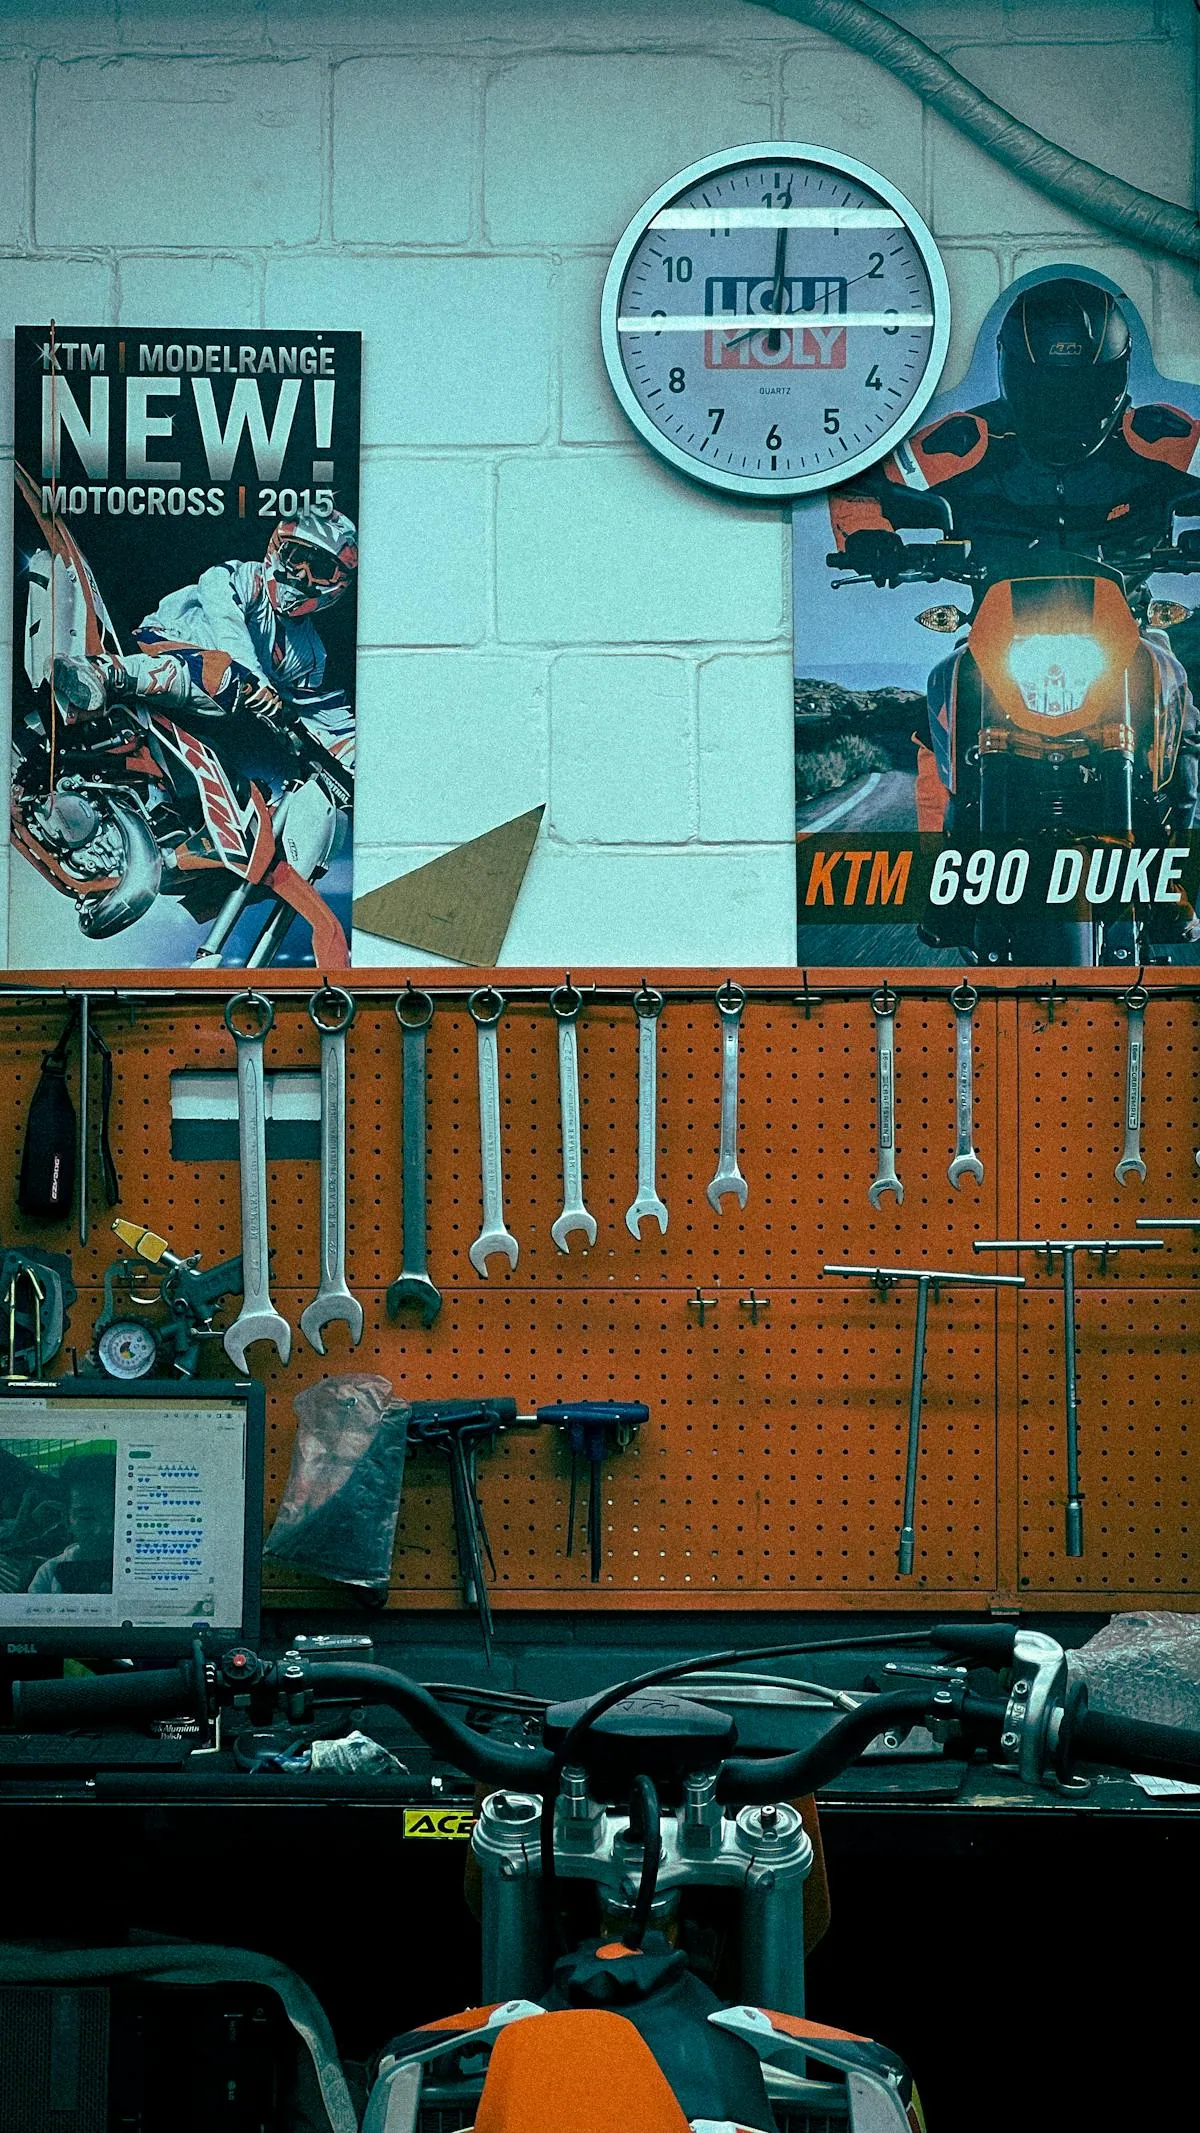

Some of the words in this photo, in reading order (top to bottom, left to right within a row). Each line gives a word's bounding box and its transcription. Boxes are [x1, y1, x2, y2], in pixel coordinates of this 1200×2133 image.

[662, 256, 693, 283] 10
[868, 252, 885, 279] 2
[712, 280, 841, 316] LIQUI
[43, 343, 105, 371] KTM
[139, 344, 335, 375] MODELRANGE
[711, 328, 845, 365] MOLY
[668, 367, 685, 393] 8
[759, 387, 791, 395] QUARTZ
[865, 364, 883, 391] 4
[41, 375, 336, 482] NEW!
[708, 408, 725, 435] 7
[823, 408, 840, 435] 5
[766, 424, 782, 451] 6
[41, 485, 225, 517] MOTOCROSS
[258, 488, 335, 518] 2015
[805, 850, 913, 905] KTM
[929, 849, 1030, 905] 690
[1046, 847, 1190, 904] DUKE
